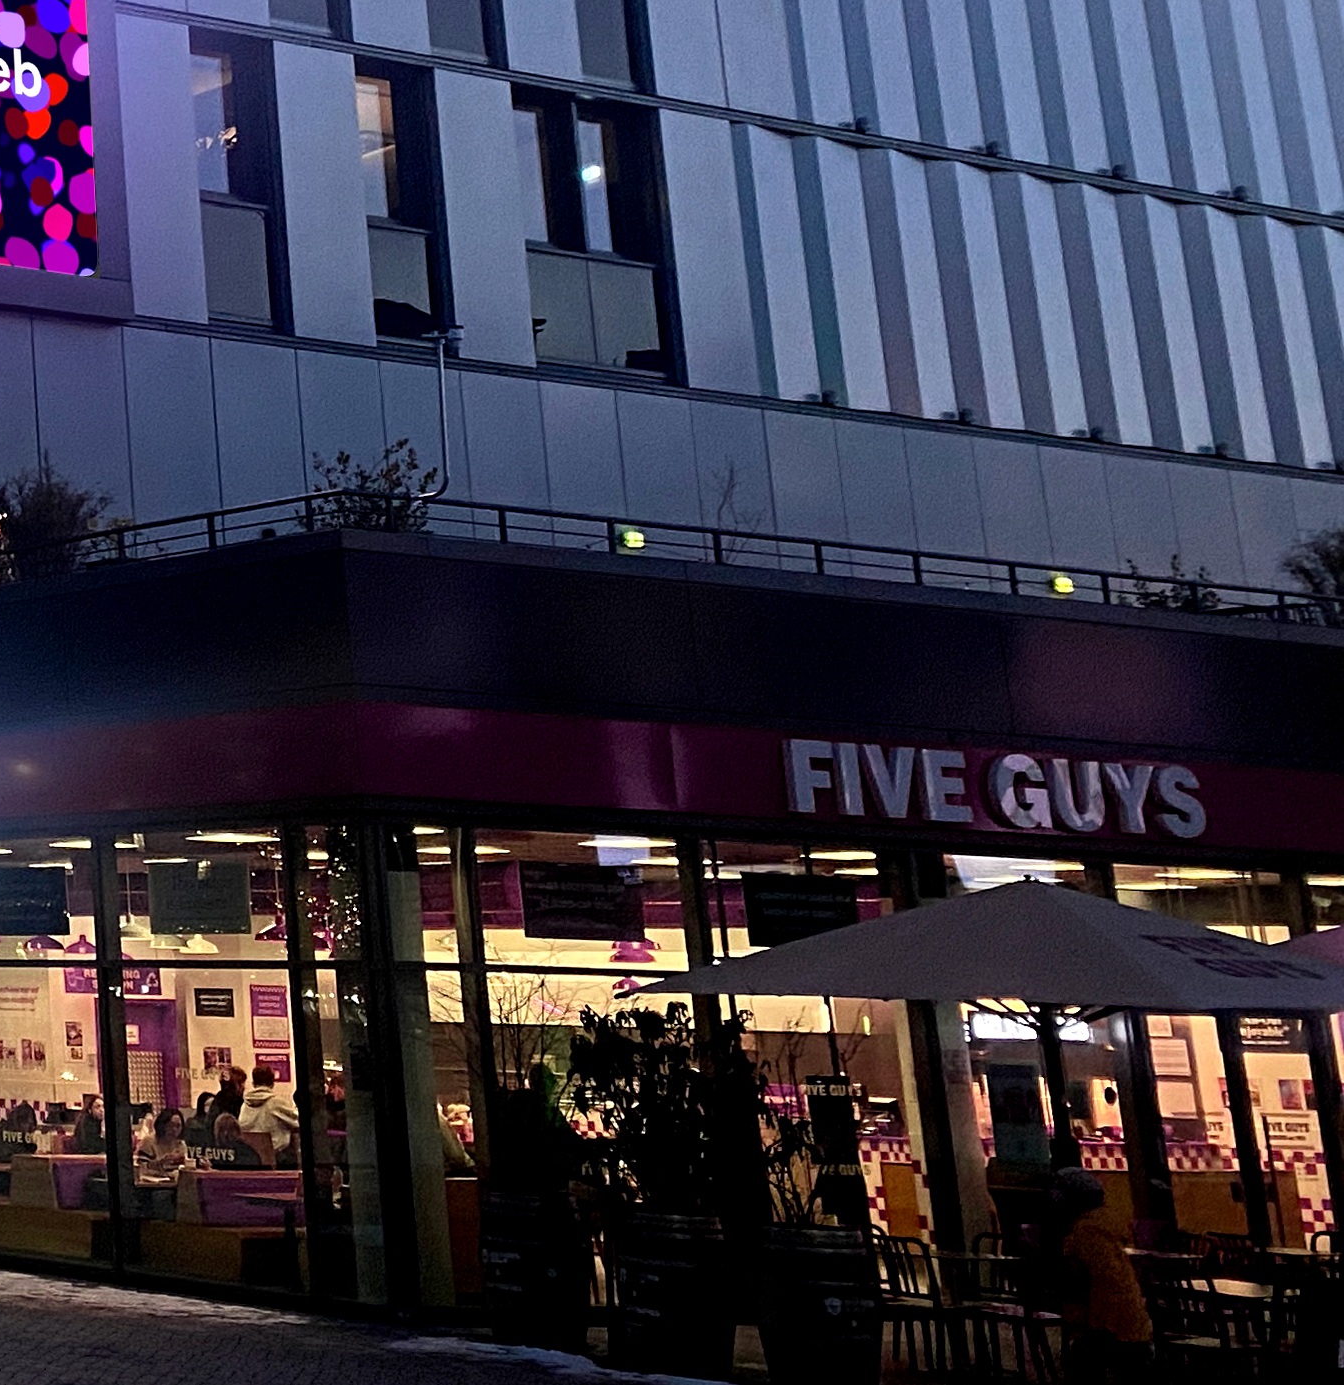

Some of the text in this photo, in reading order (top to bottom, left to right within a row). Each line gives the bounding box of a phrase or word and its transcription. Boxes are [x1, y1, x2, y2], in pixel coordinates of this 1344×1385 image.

[783, 739, 1207, 839] FIVE GUYS
[205, 1148, 235, 1161] GUYS
